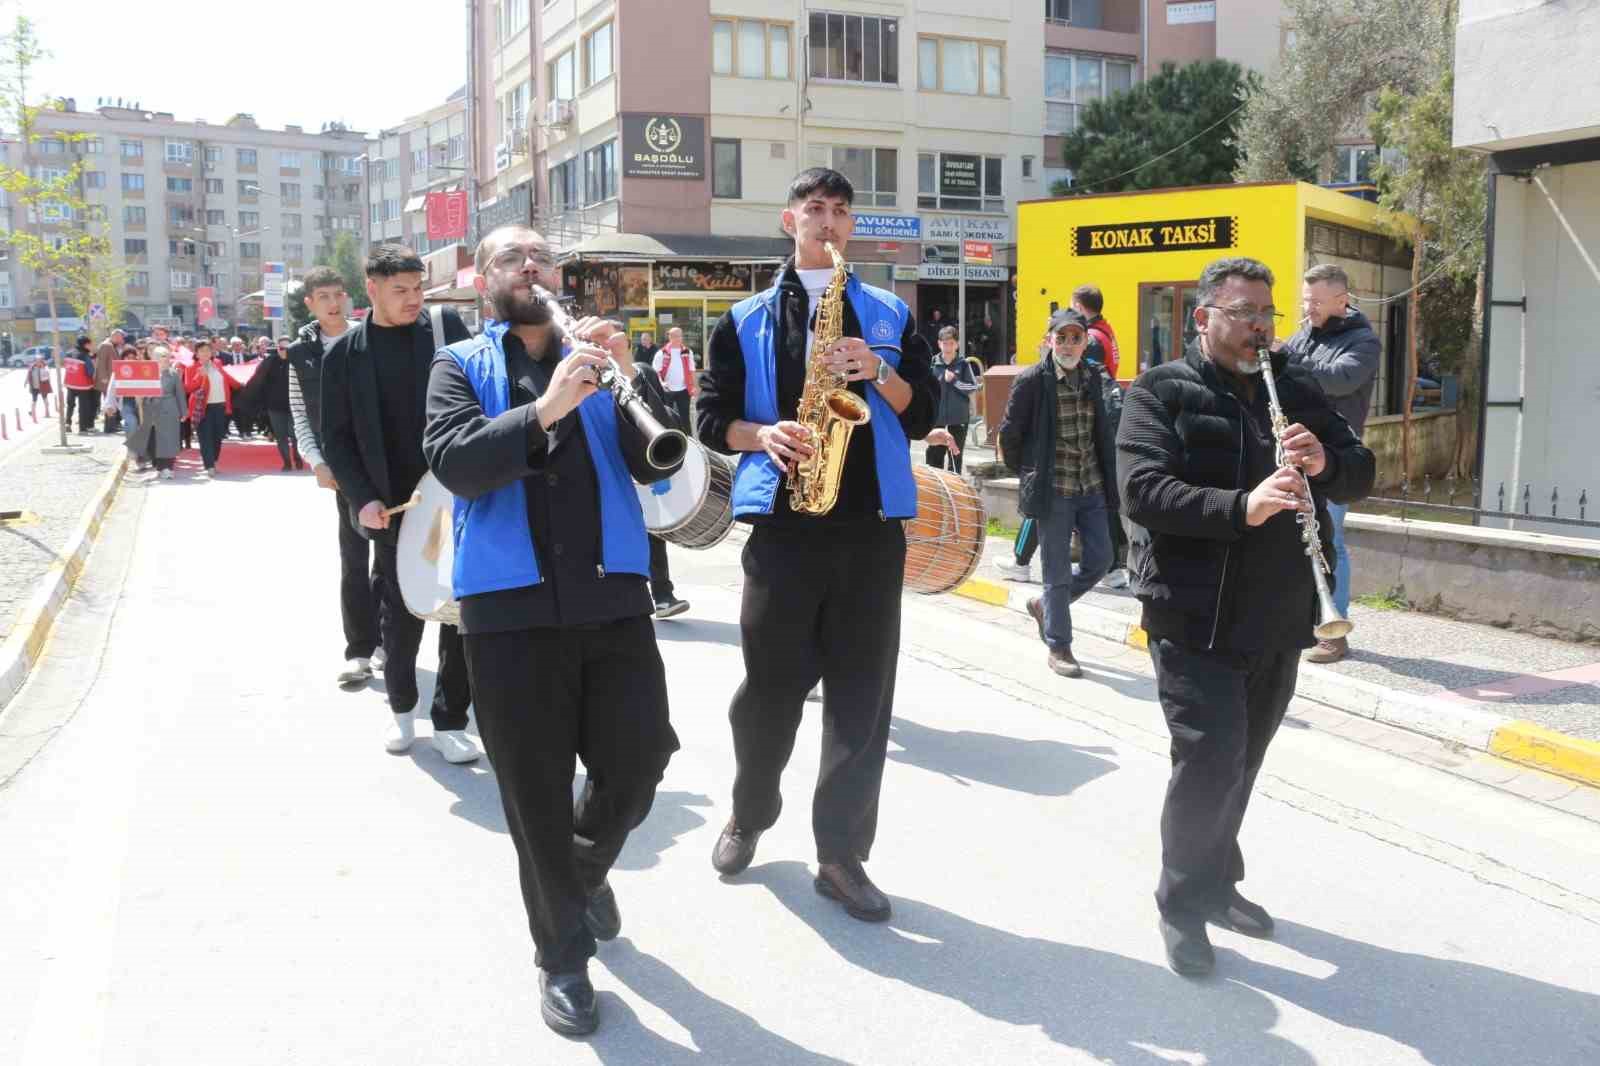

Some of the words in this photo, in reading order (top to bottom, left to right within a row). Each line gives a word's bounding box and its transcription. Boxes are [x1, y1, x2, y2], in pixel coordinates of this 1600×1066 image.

[634, 153, 694, 164] BAŞOĞLU
[855, 216, 913, 227] AVUKAT
[1090, 228, 1154, 250] KONAK
[1160, 219, 1217, 245] TAKSİ
[660, 265, 698, 279] Kafe
